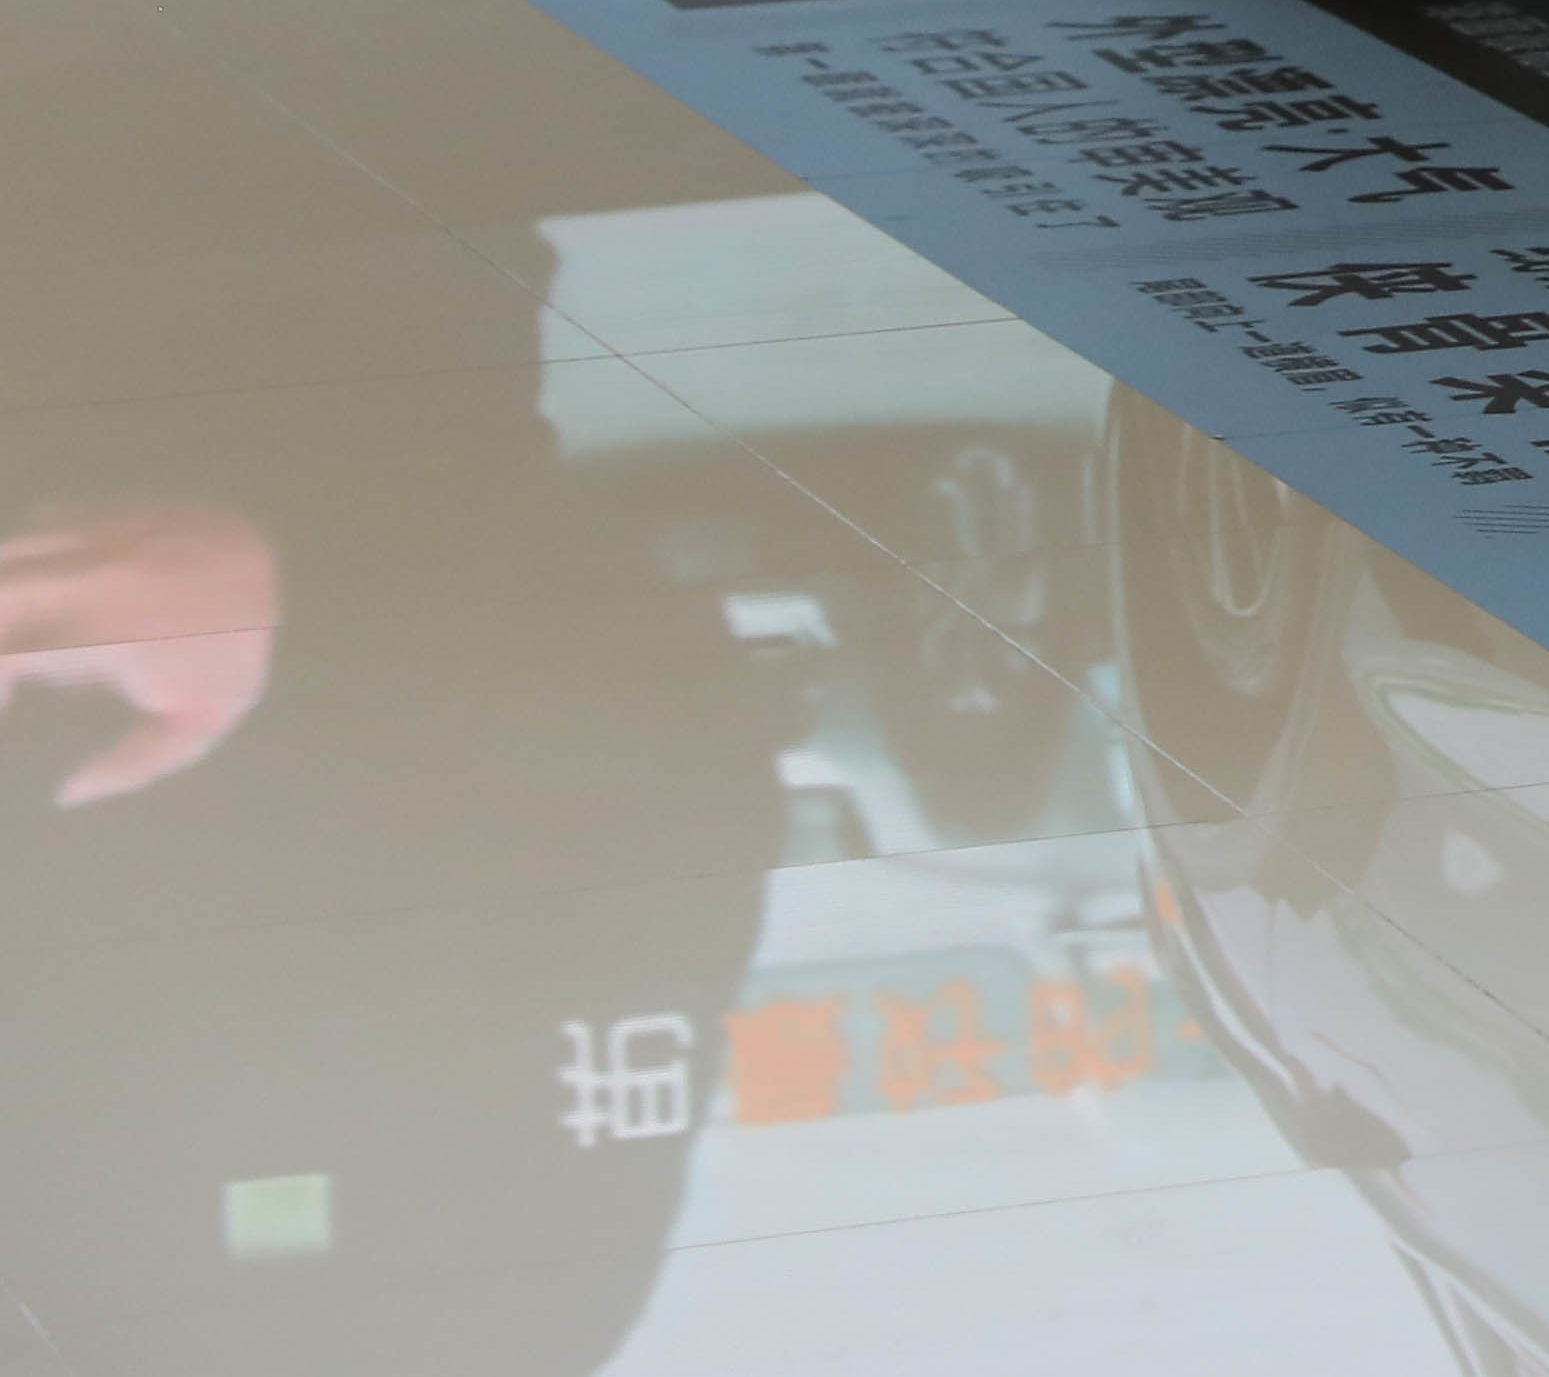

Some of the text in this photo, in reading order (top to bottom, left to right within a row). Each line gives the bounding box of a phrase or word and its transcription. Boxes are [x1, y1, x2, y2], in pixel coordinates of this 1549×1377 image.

[869, 27, 1302, 224] 符合国人的审美观
